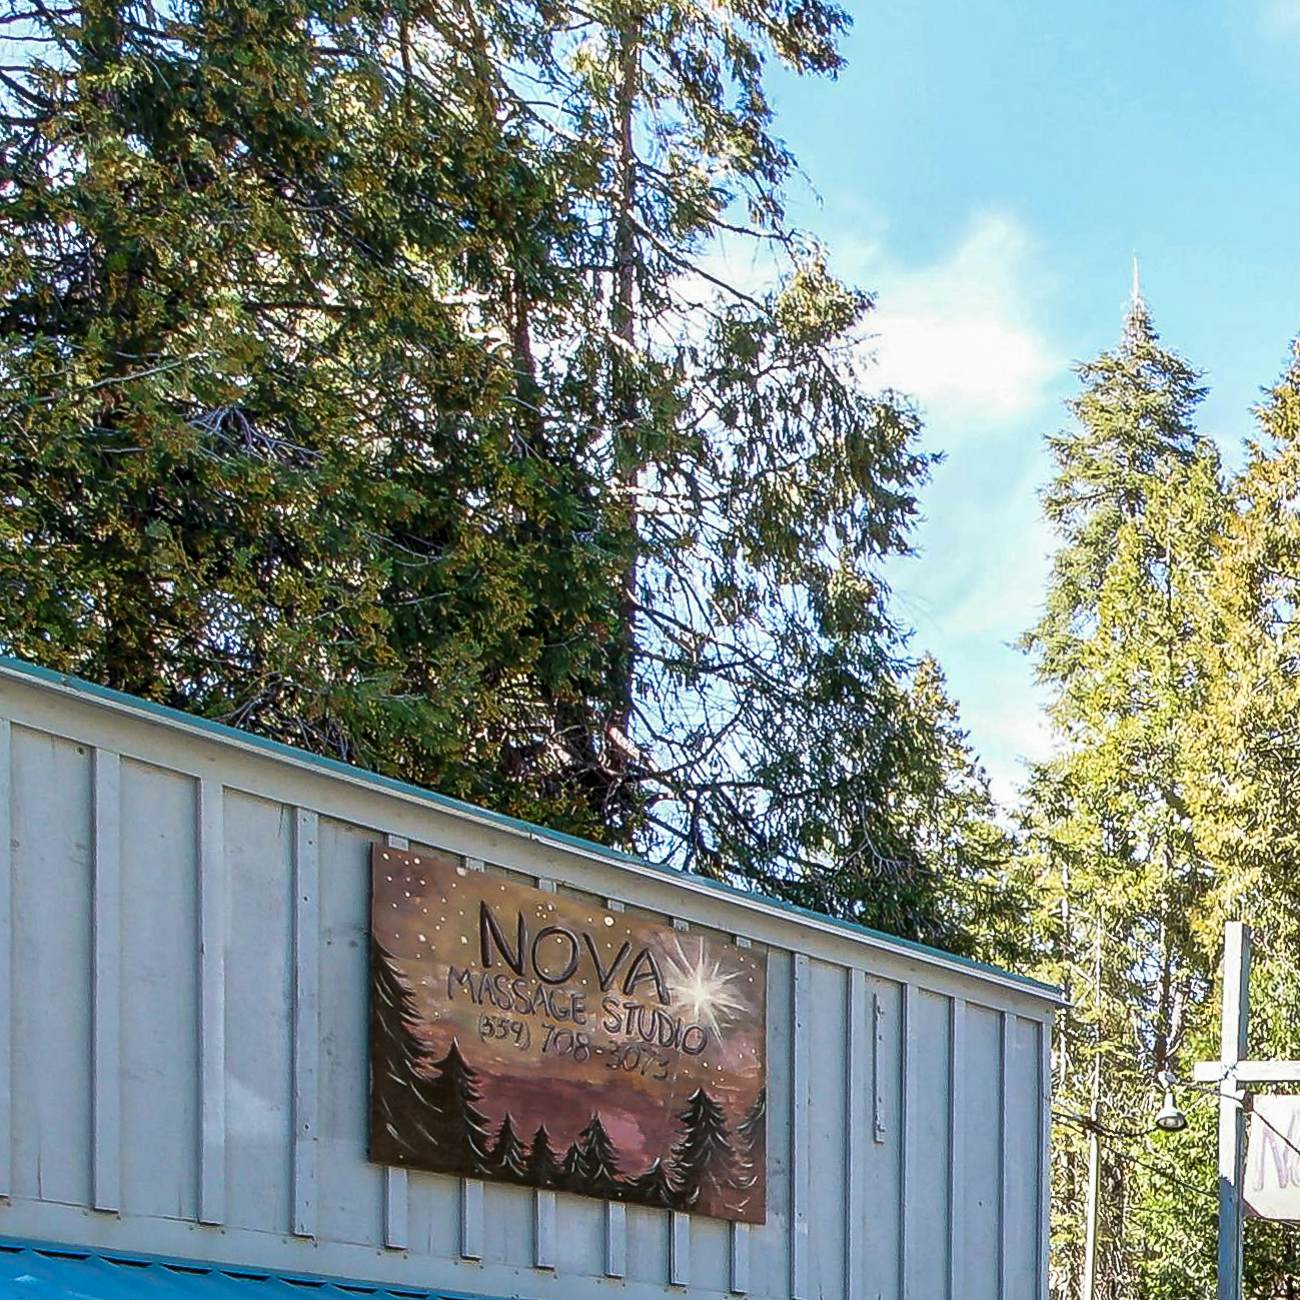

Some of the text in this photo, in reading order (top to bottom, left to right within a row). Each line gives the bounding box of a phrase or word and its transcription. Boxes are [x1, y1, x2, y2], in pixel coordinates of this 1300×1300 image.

[480, 900, 671, 1006] NOVA
[447, 965, 708, 1055] MASSAGE STUDIO
[479, 1012, 531, 1050] (559)
